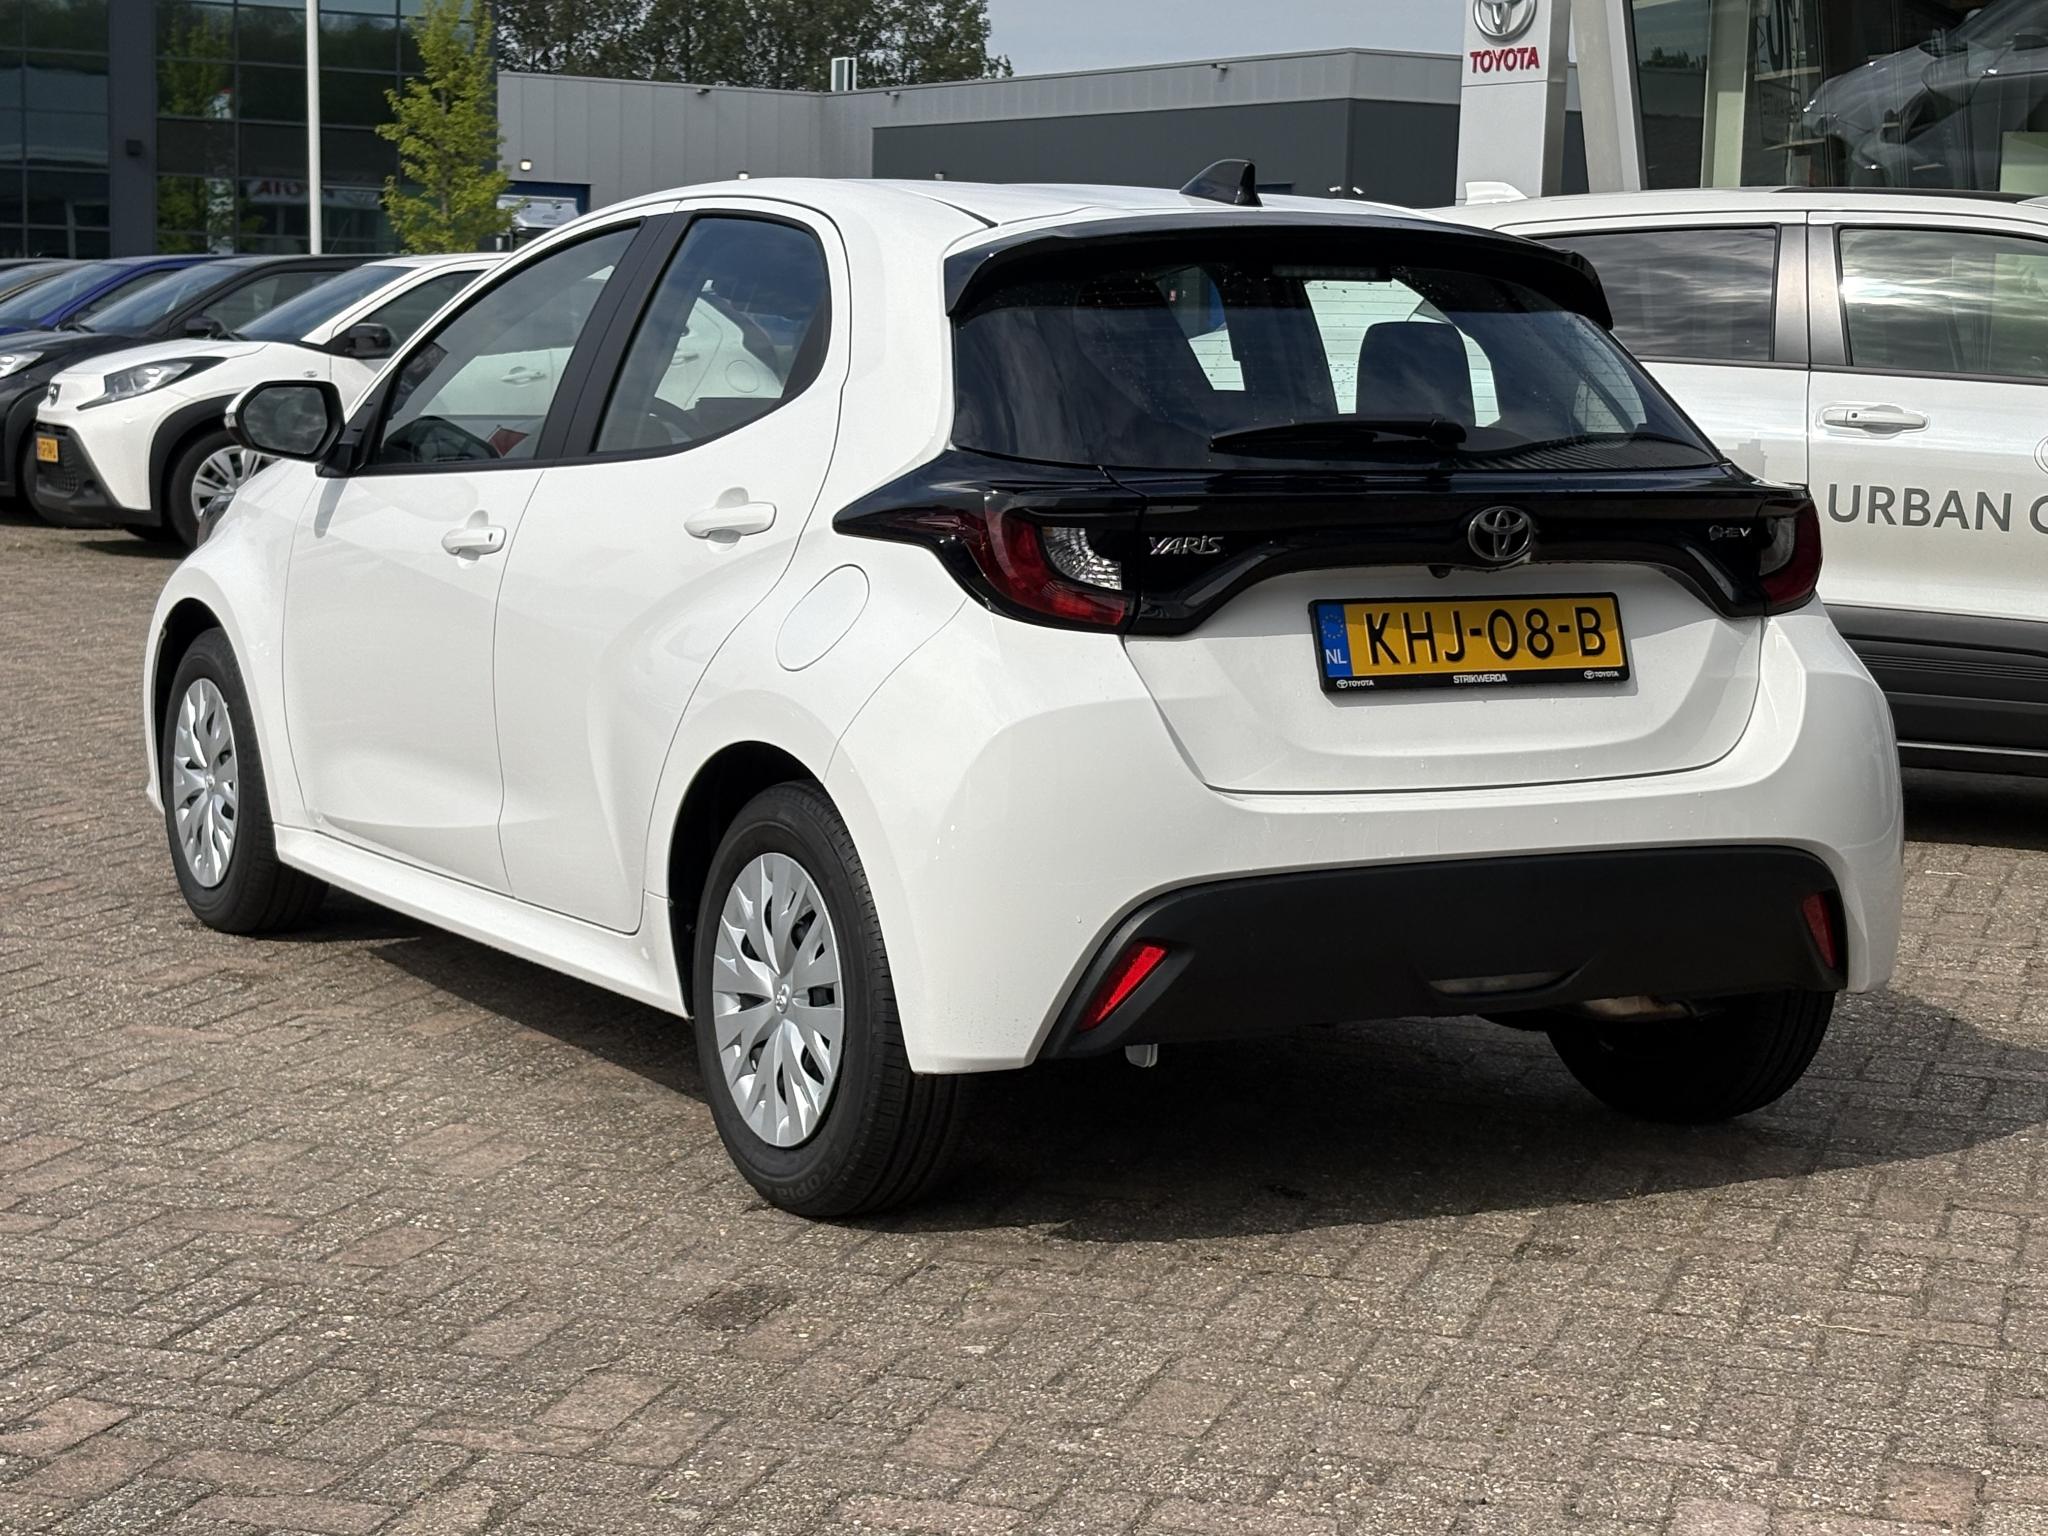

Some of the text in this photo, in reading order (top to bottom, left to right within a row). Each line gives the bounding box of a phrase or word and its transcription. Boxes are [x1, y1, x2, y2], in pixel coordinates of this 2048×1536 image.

[1470, 46, 1540, 73] TOYOTA
[1828, 483, 2012, 532] URBAN
[1149, 535, 1224, 555] YARIS
[1325, 606, 1606, 665] NL KHJ-08-B
[1348, 670, 1619, 688] TOYOTA STRIKWERDA TOYOTA
